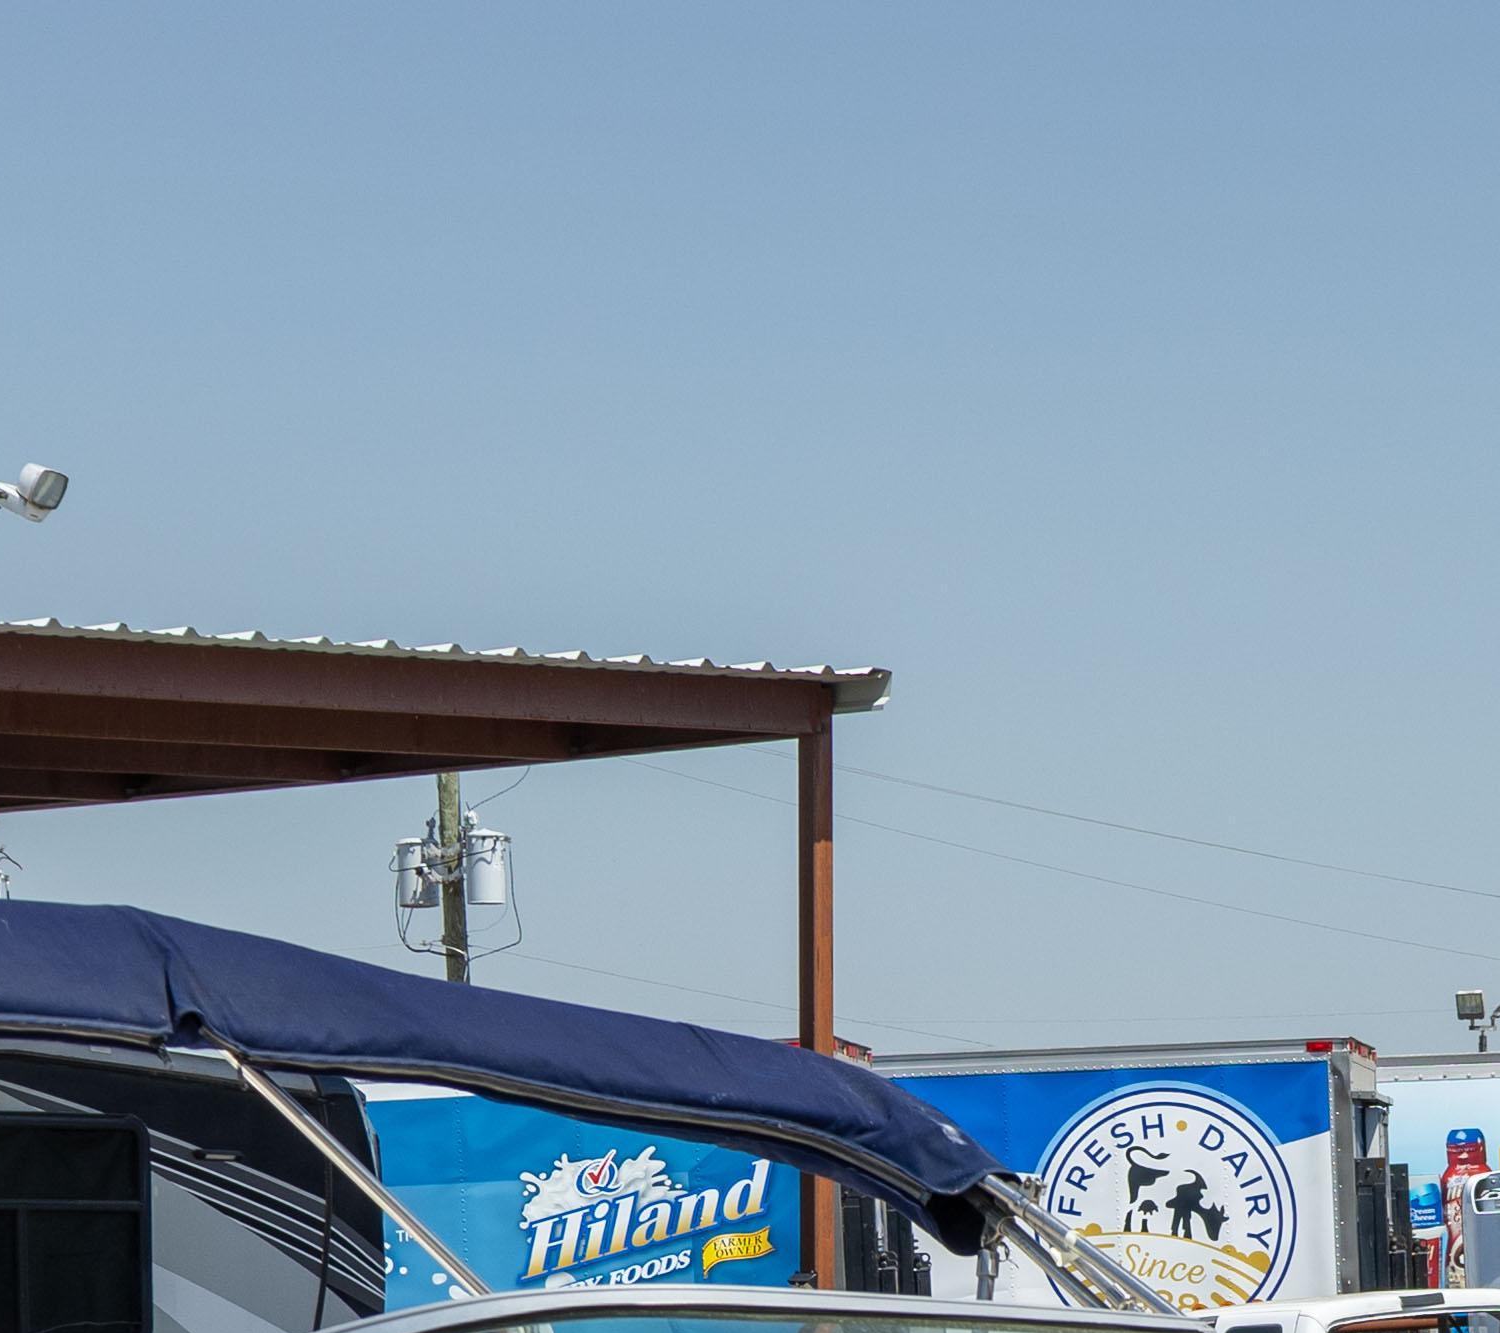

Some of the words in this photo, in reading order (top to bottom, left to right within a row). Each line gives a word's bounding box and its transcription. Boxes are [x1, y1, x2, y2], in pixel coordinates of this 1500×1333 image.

[1058, 1113, 1165, 1217] FRESH
[1198, 1123, 1274, 1250] DAIRY
[519, 1158, 772, 1281] Hiland
[713, 1235, 763, 1250] FARMER
[716, 1245, 762, 1258] OWNED
[609, 1249, 692, 1286] FOODS
[1125, 1243, 1208, 1285] Since
